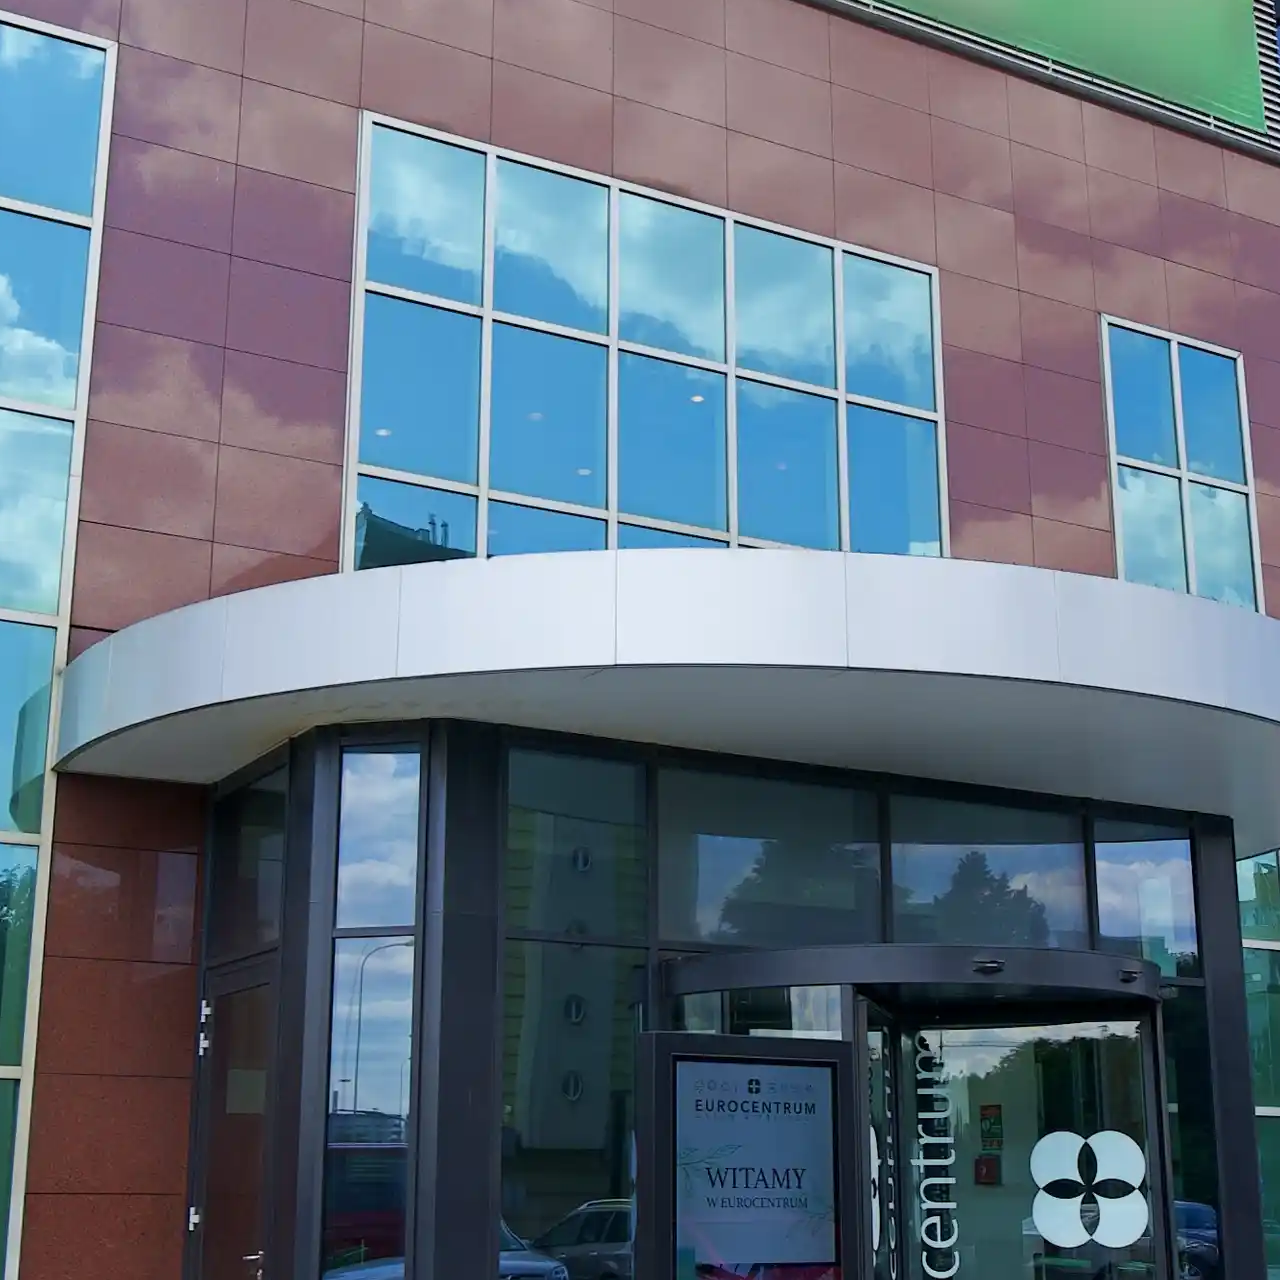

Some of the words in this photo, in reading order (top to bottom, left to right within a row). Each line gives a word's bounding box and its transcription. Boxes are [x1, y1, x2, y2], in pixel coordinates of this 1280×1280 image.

[694, 1099, 816, 1115] EUROCENTRUM
[705, 1167, 806, 1189] WITAMY
[706, 1197, 716, 1208] W
[721, 1197, 808, 1209] EUROCENTRUM
